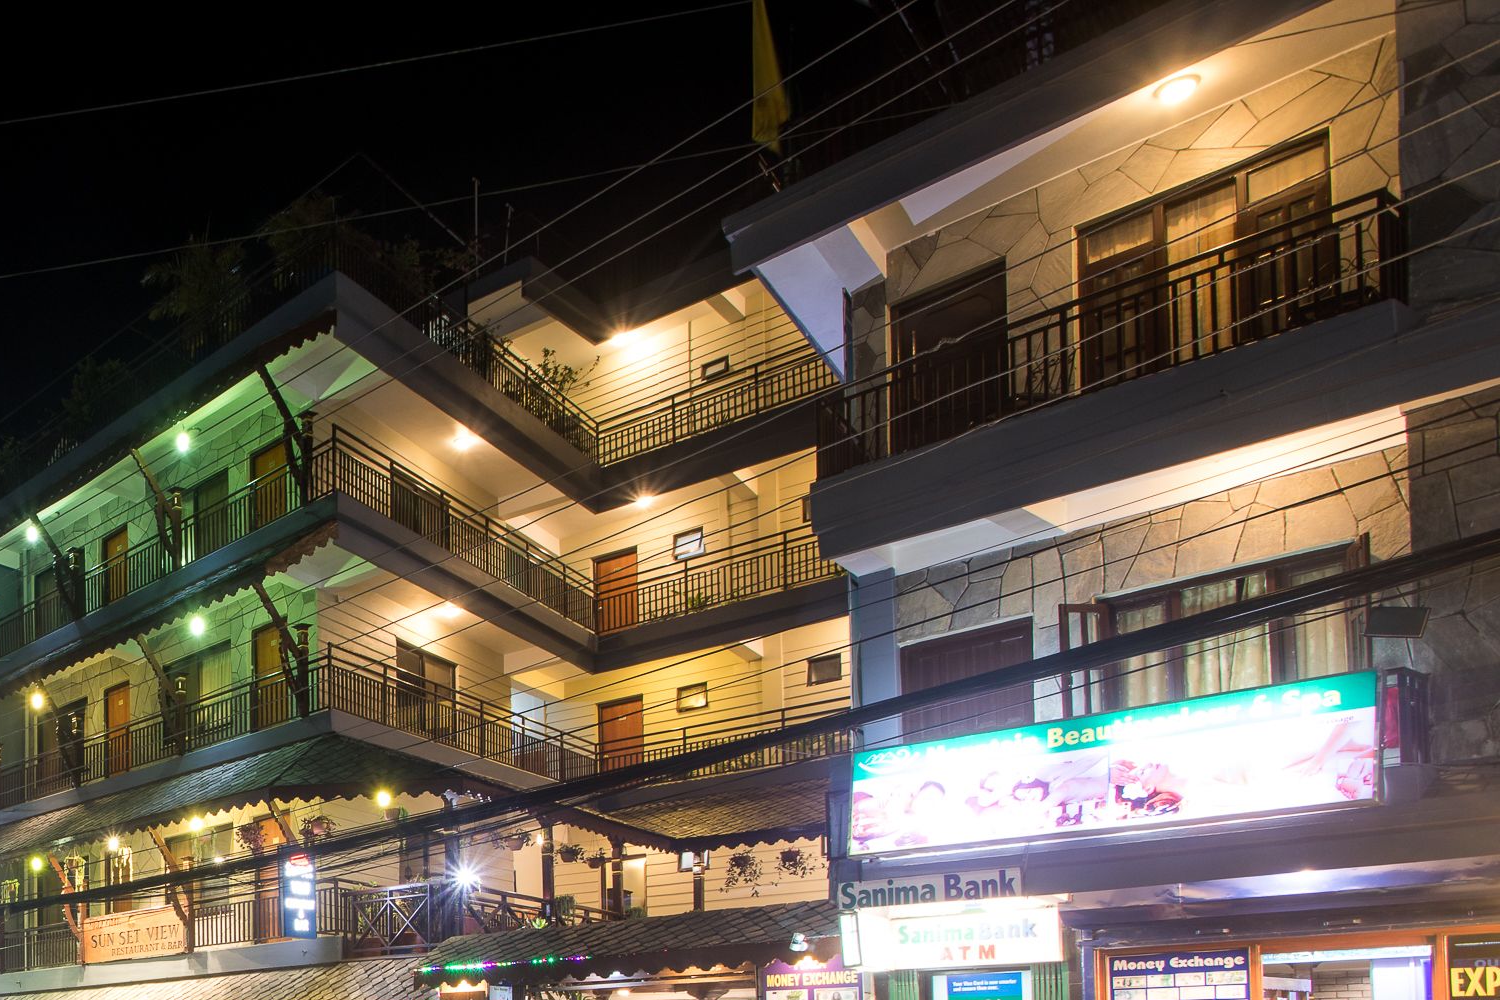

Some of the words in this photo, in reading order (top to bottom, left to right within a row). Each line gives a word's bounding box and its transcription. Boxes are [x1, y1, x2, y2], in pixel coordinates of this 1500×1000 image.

[840, 878, 937, 910] Sanima
[944, 869, 1016, 900] Bank
[91, 932, 115, 949] SUN
[119, 929, 141, 946] SET
[146, 924, 180, 941] VIEW
[898, 923, 975, 945] Sanima
[979, 918, 1038, 941] Bank
[111, 942, 160, 957] RESTAURANT
[1113, 959, 1165, 972] Money
[1170, 955, 1245, 969] Exchange
[766, 973, 801, 988] MONEY
[802, 971, 859, 987] EXCHANGE
